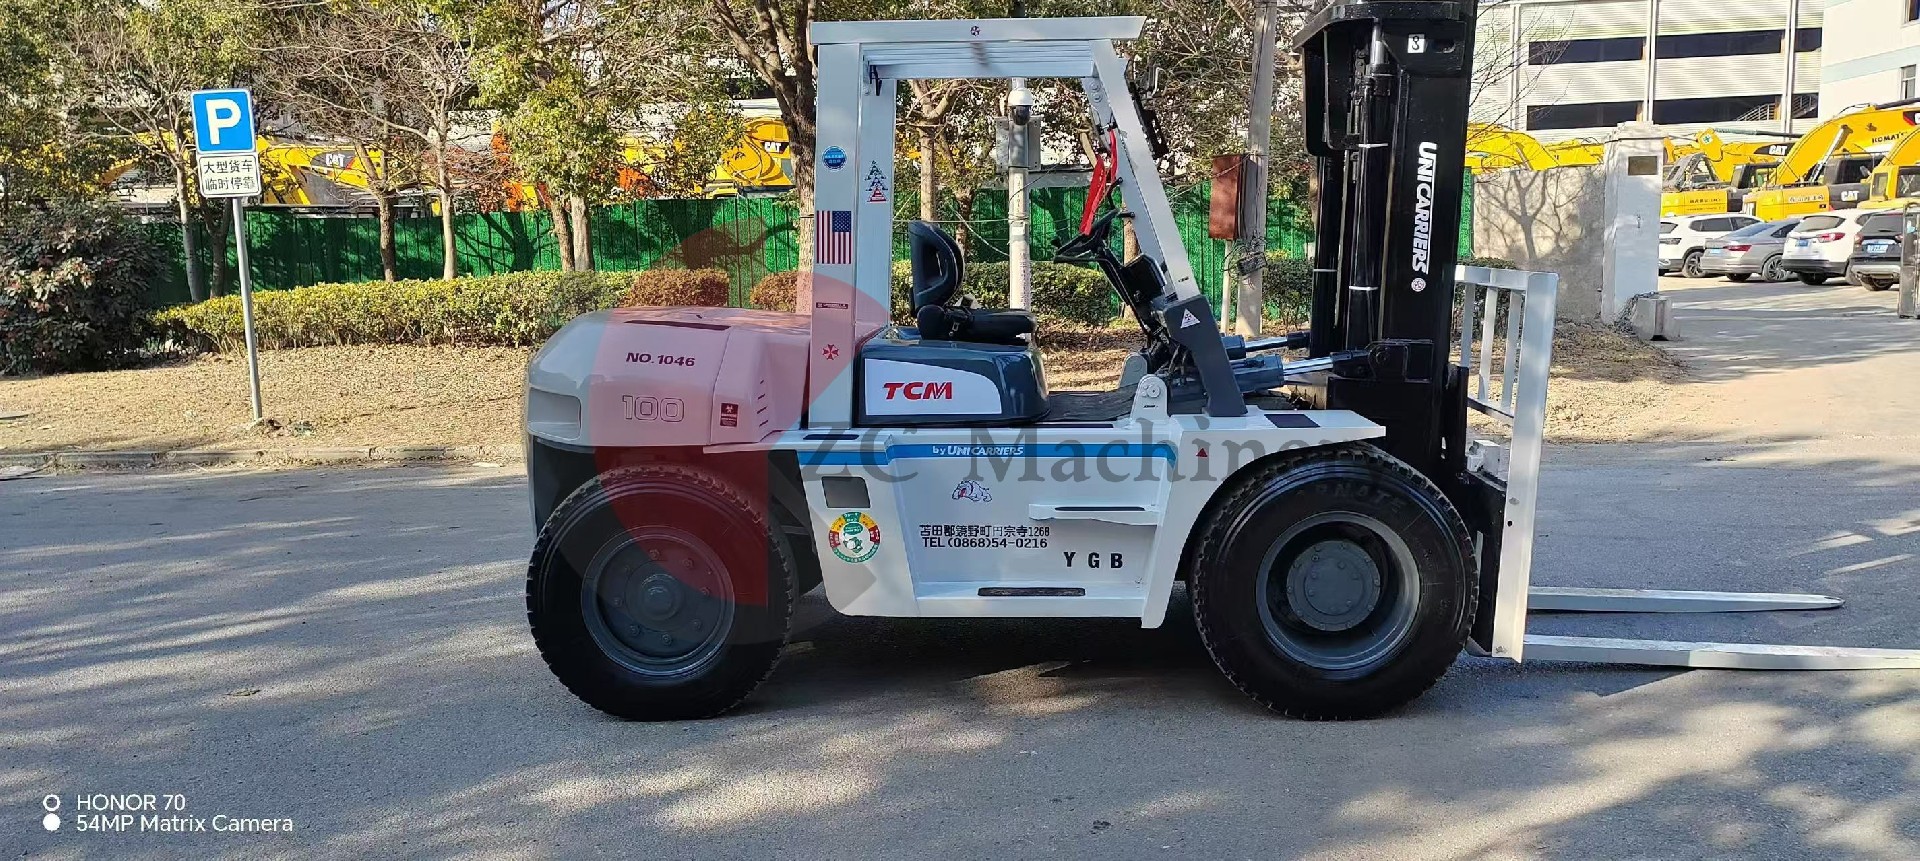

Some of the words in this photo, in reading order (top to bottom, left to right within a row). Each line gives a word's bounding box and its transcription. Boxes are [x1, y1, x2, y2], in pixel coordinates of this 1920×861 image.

[205, 98, 242, 145] P
[1872, 131, 1908, 143] KOMAT
[764, 141, 782, 152] CAT
[1768, 145, 1787, 156] CAT
[204, 159, 254, 174] 大型货车
[325, 153, 346, 167] CAT
[205, 176, 256, 191] 临时停靠
[1841, 190, 1860, 201] CAT
[1412, 141, 1438, 274] UNICARRIERS
[883, 381, 953, 401] TCM
[622, 395, 685, 423] 100
[932, 445, 946, 456] by
[947, 445, 1024, 456] UNICARRIERS
